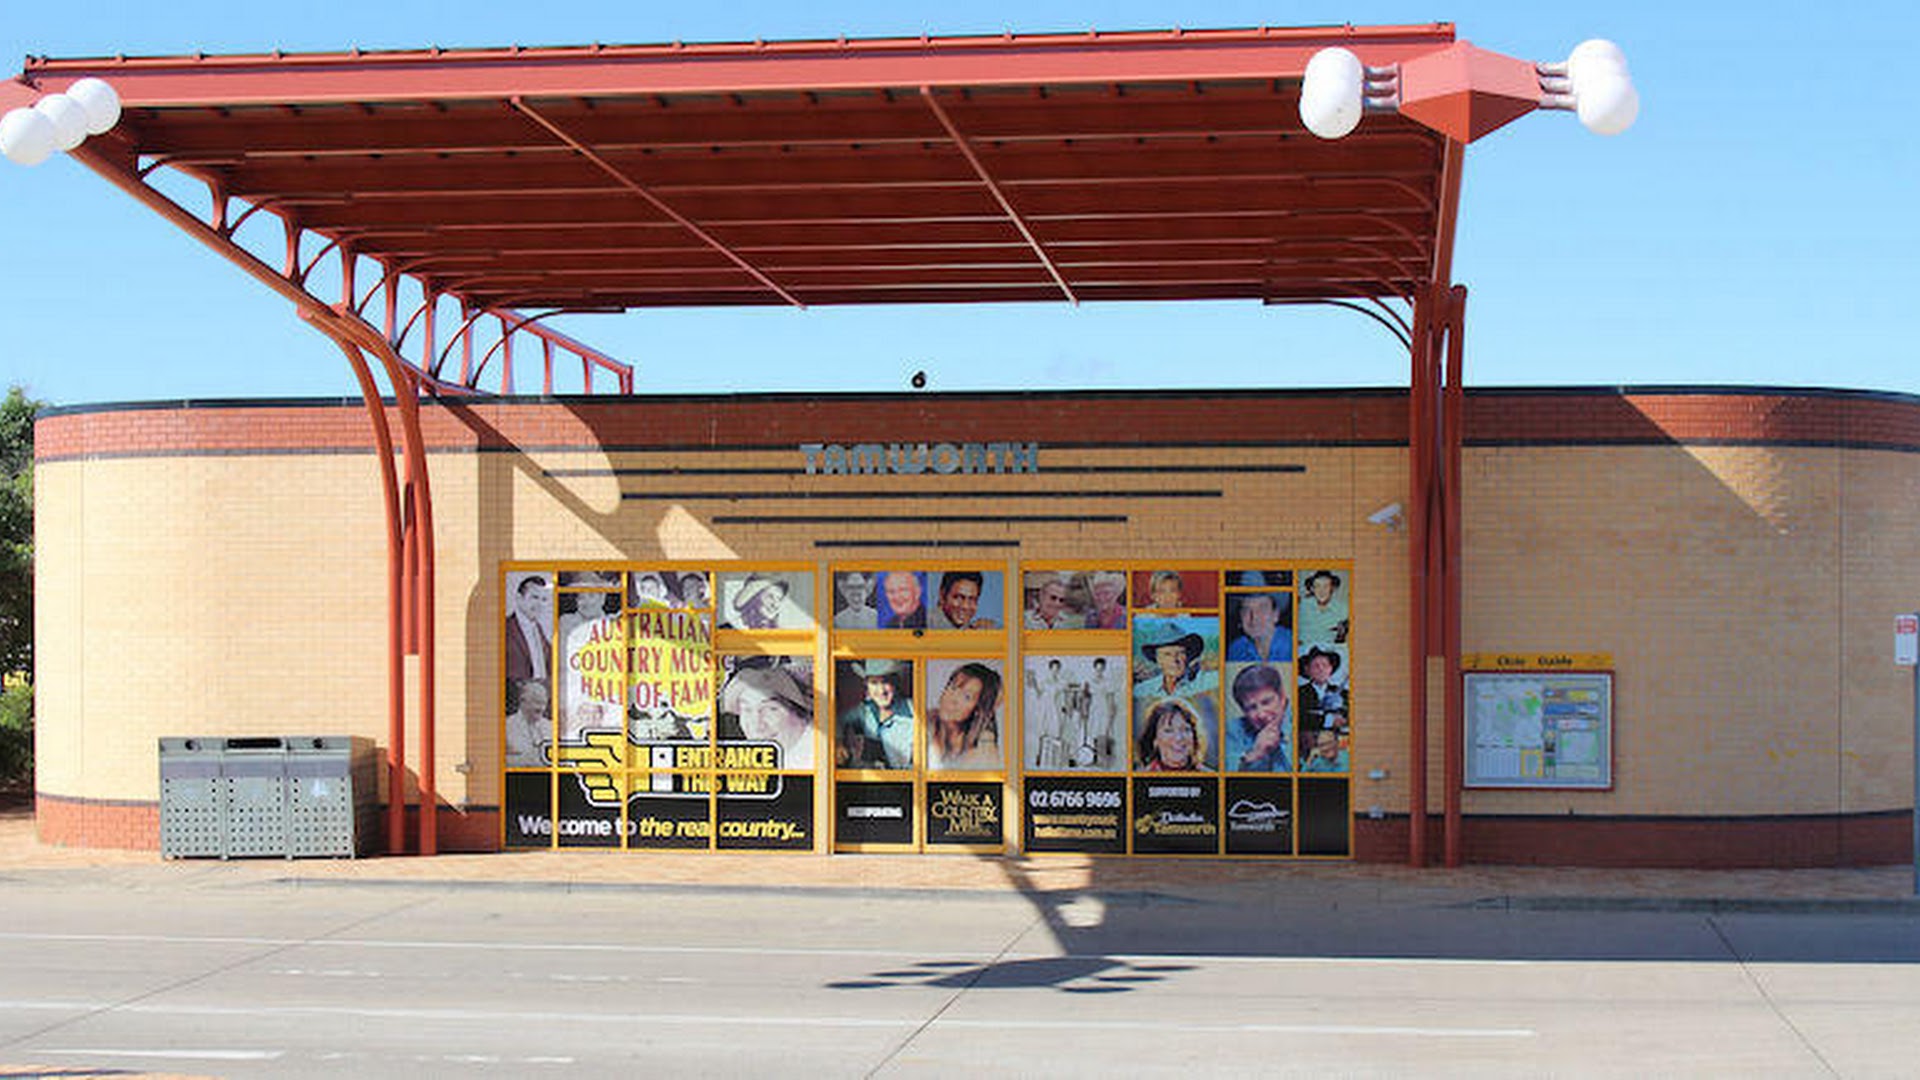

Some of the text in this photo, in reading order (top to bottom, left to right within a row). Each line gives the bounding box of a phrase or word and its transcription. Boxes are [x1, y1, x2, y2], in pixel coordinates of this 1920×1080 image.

[799, 443, 1039, 474] TAMWORTH
[589, 612, 711, 644] AUSTRALIAN
[570, 647, 663, 674] COUNTRY
[636, 681, 662, 708] OF
[671, 677, 719, 708] FAM
[676, 747, 774, 768] ENTRANCE
[726, 773, 769, 792] WAY
[1029, 790, 1049, 808] 02
[1049, 790, 1085, 808] 6766
[518, 815, 612, 836] Wecome
[639, 817, 673, 837] the
